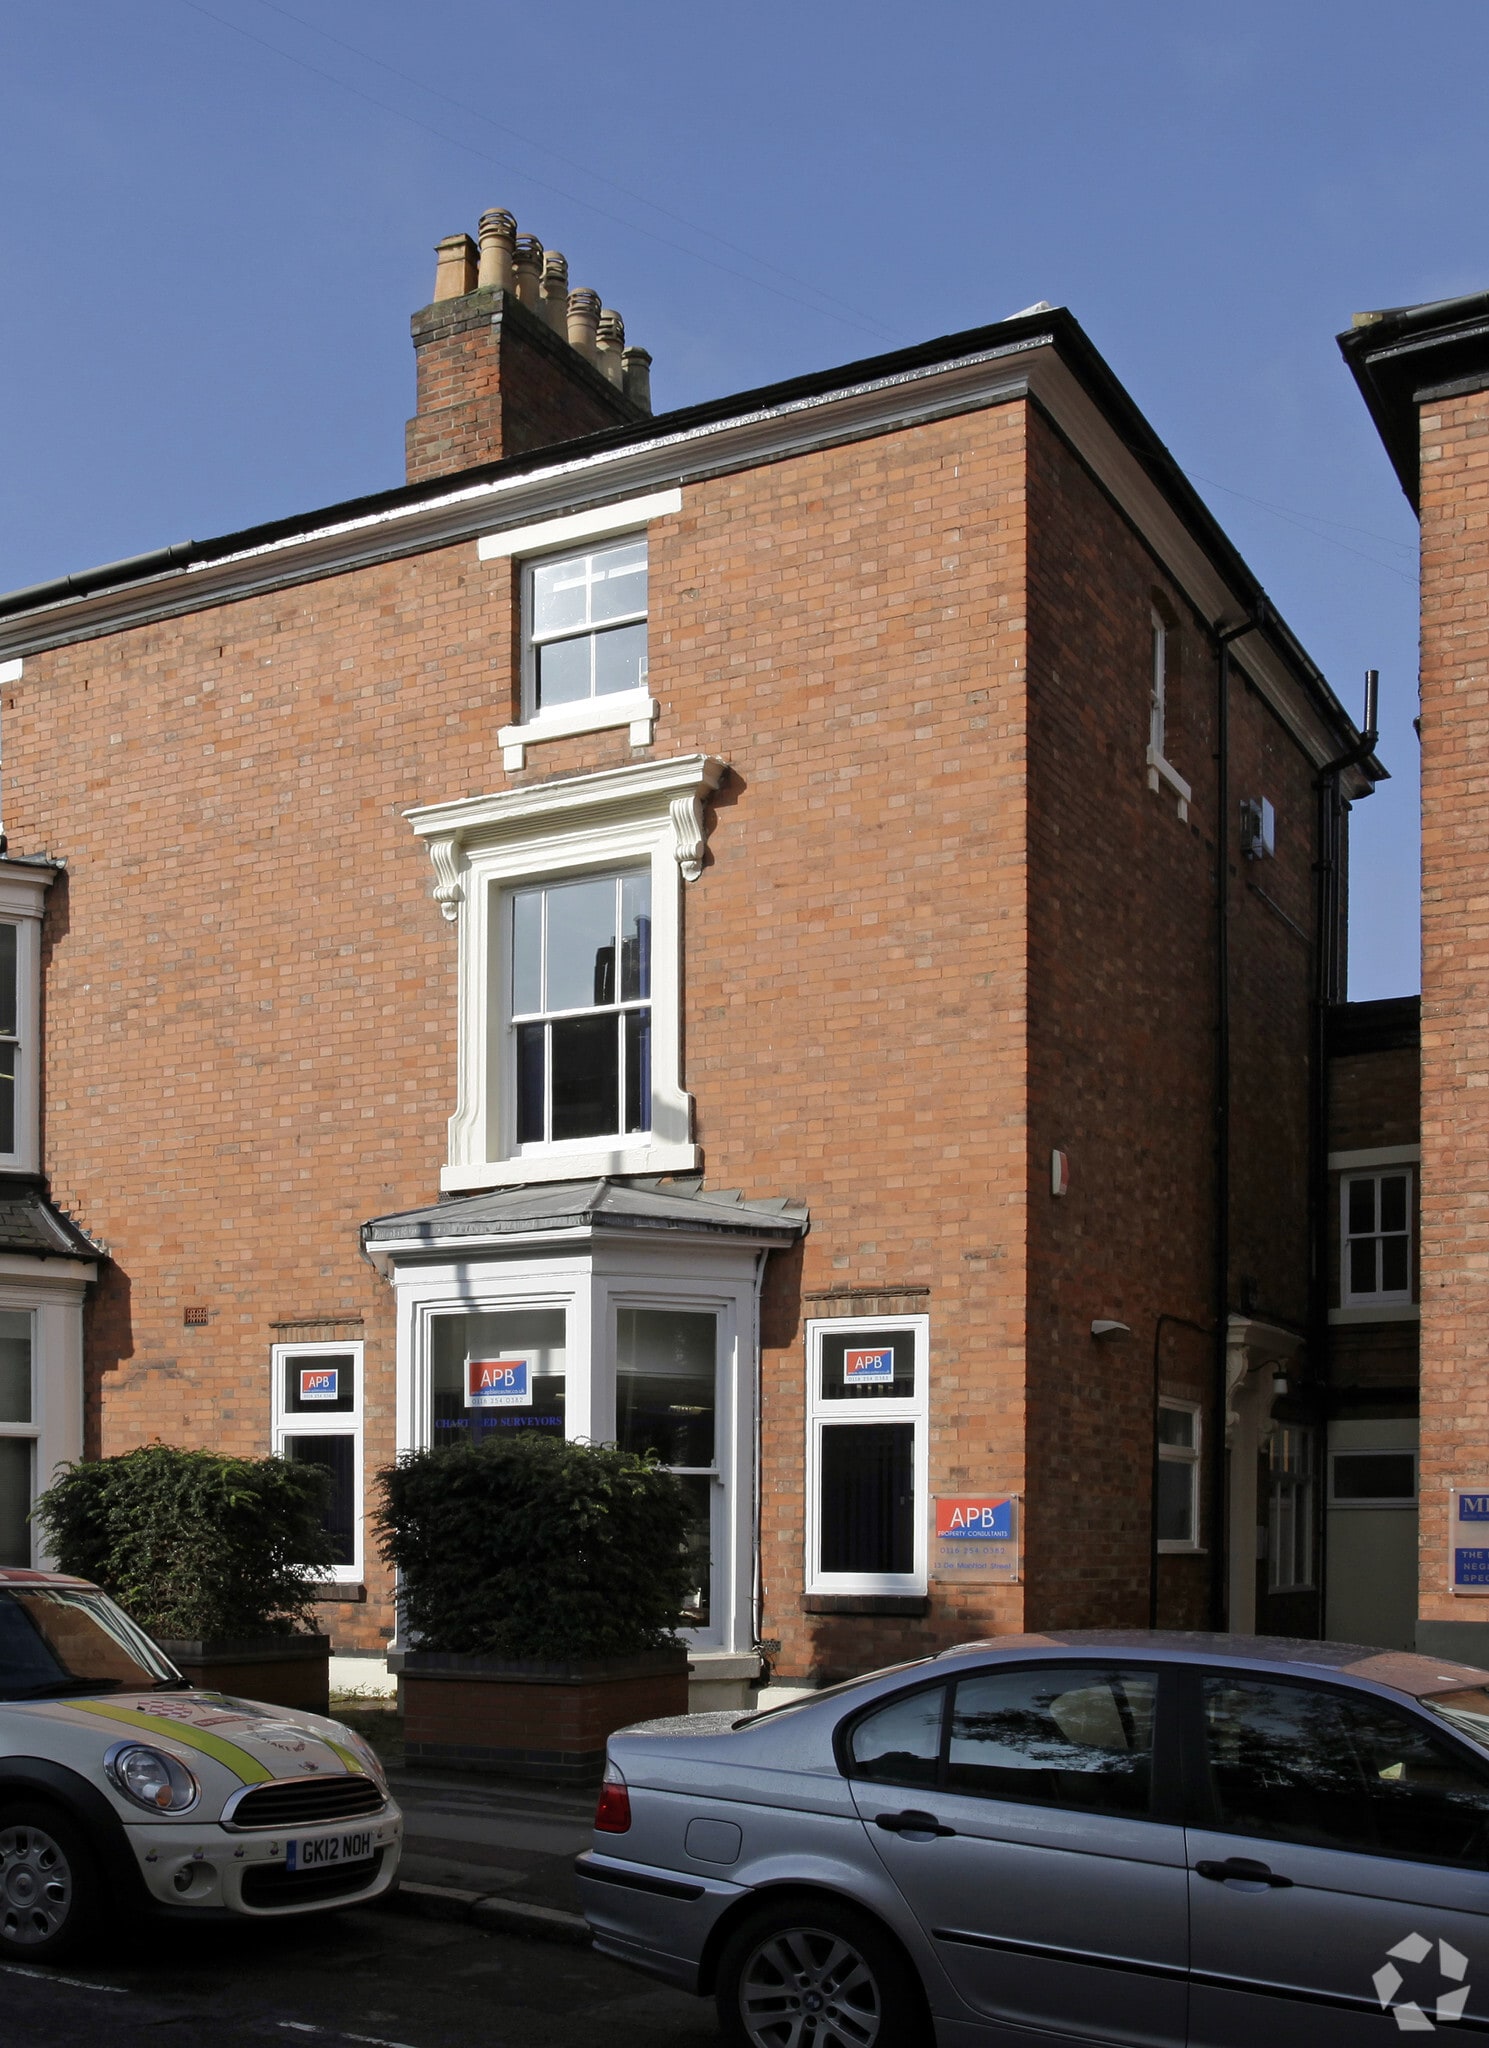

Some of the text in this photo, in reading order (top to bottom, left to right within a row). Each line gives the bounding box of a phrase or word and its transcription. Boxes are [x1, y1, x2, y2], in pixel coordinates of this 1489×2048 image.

[855, 1355, 882, 1369] APB
[308, 1376, 330, 1388] APB
[480, 1368, 515, 1387] APB
[435, 1415, 563, 1429] CHARTED SURVEYORS
[949, 1507, 995, 1528] APB
[1462, 1551, 1483, 1559] THE
[1463, 1562, 1489, 1570] NEG
[302, 1832, 371, 1864] GK12 NOH
